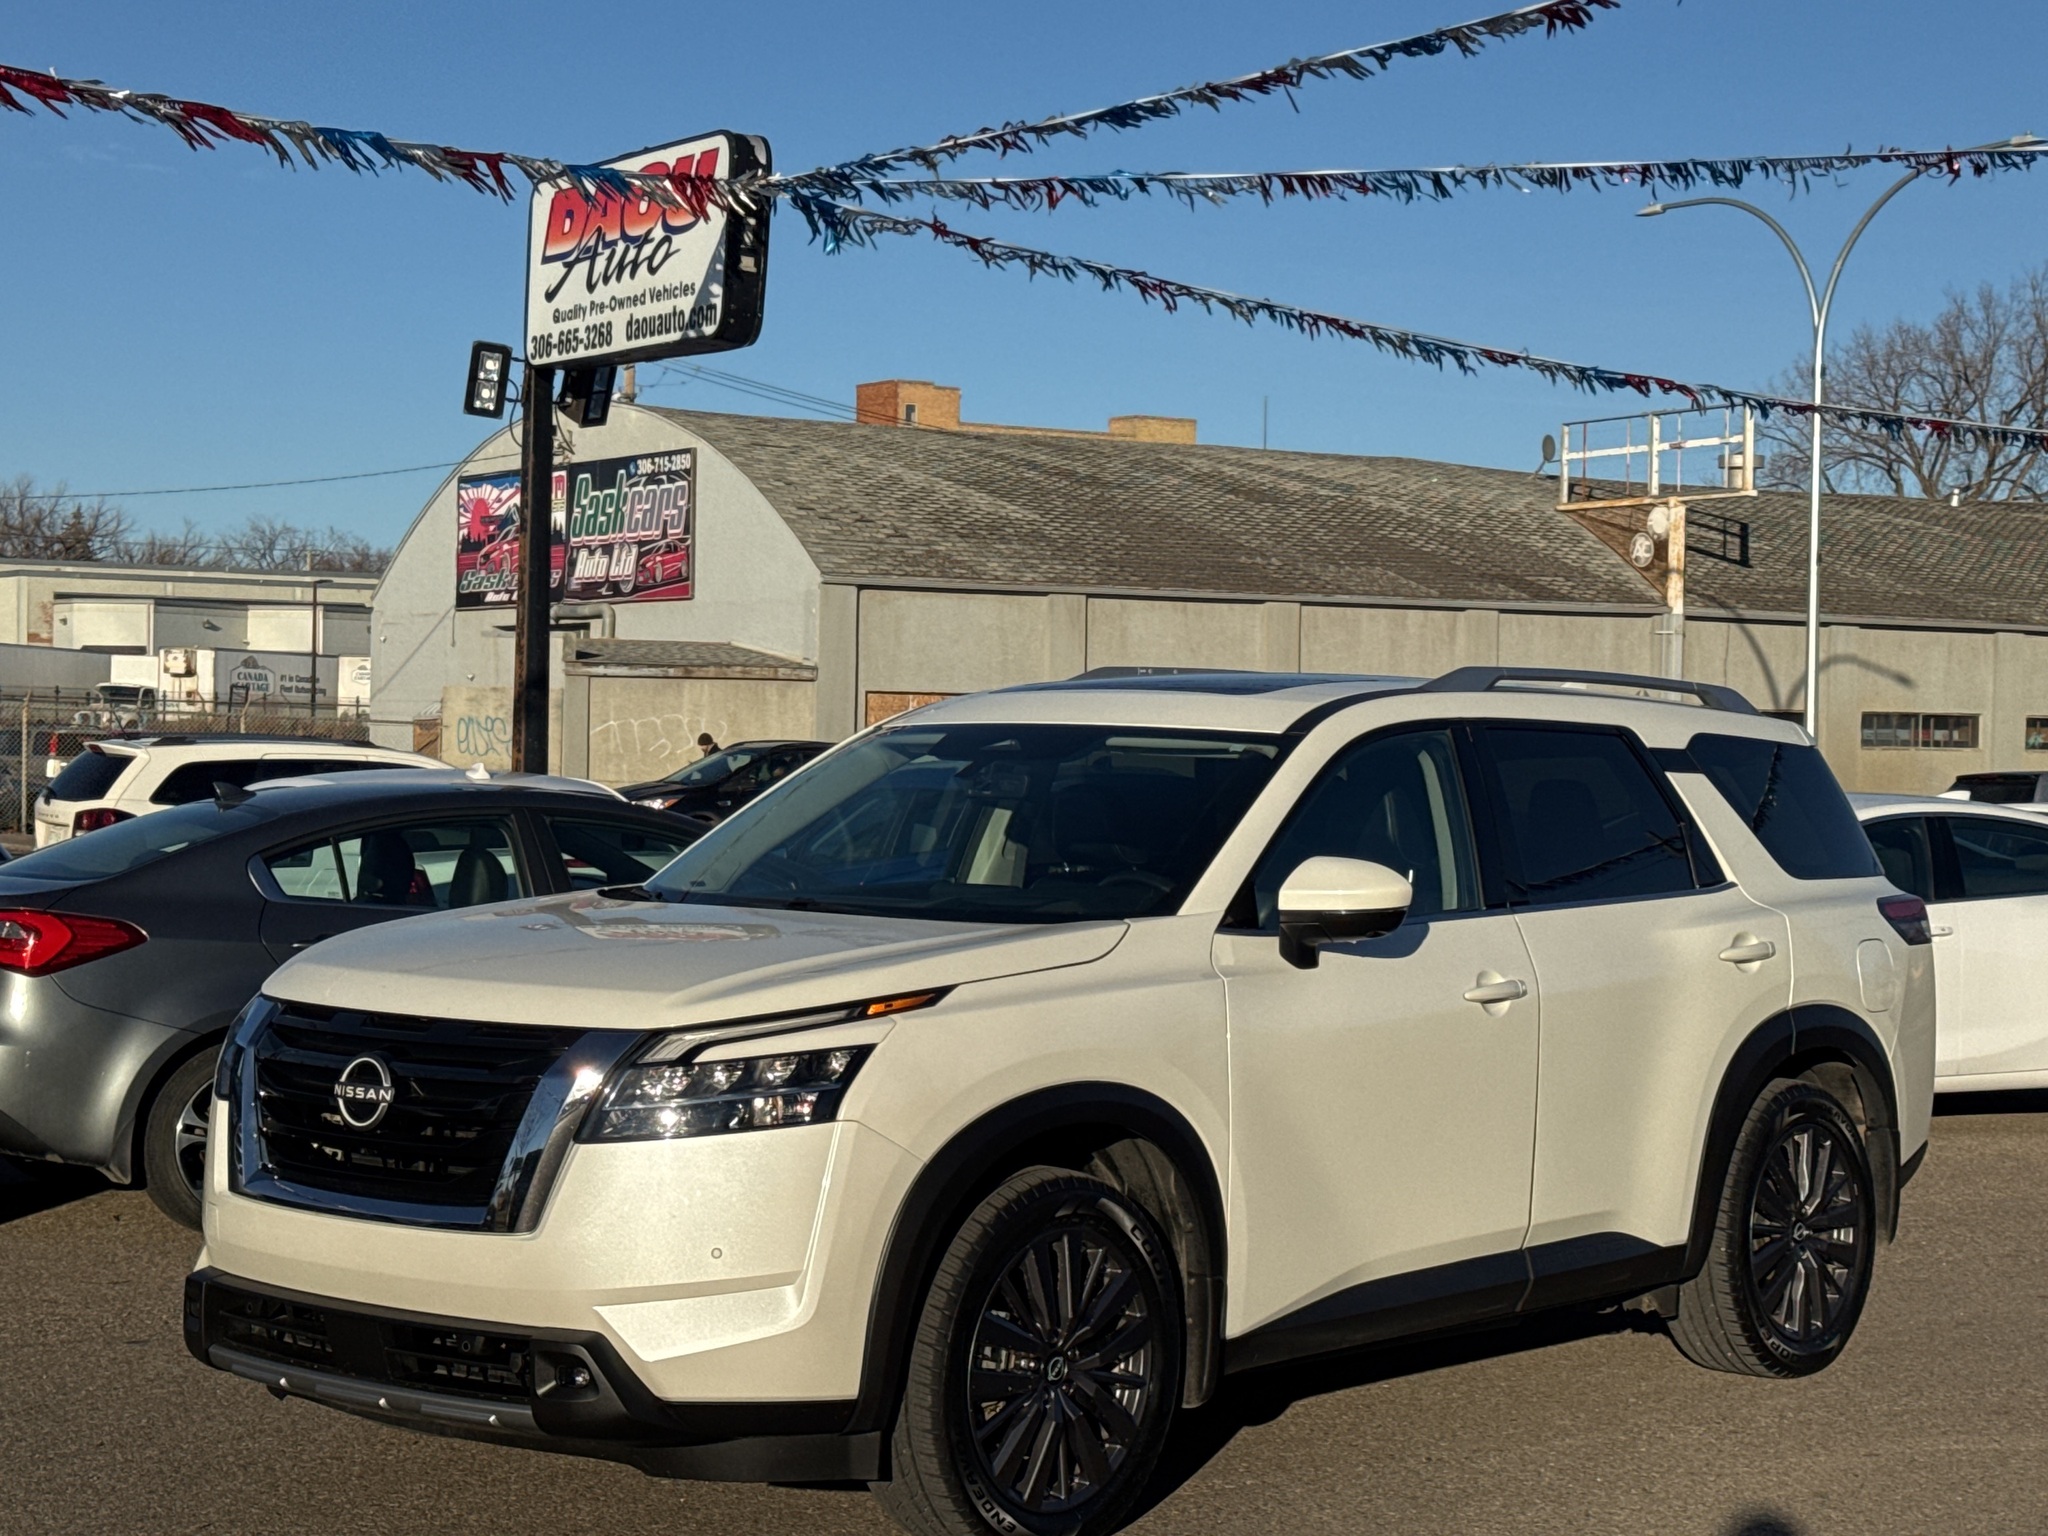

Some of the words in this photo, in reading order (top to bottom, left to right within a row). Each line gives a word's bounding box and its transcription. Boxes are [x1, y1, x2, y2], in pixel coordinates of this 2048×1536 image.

[541, 147, 720, 265] DAOU
[544, 224, 682, 303] Auto
[552, 304, 588, 324] Quality
[589, 289, 647, 317] Pre-Owned
[649, 280, 696, 305] Vehicles
[530, 320, 613, 361] 306-665-3268
[625, 302, 718, 343] daouauto.com
[636, 453, 692, 475] 306-715-2850
[573, 547, 610, 583] Auto
[608, 543, 639, 581] Ltd
[237, 671, 268, 682] CANADA
[334, 1084, 392, 1101] NISSAN
